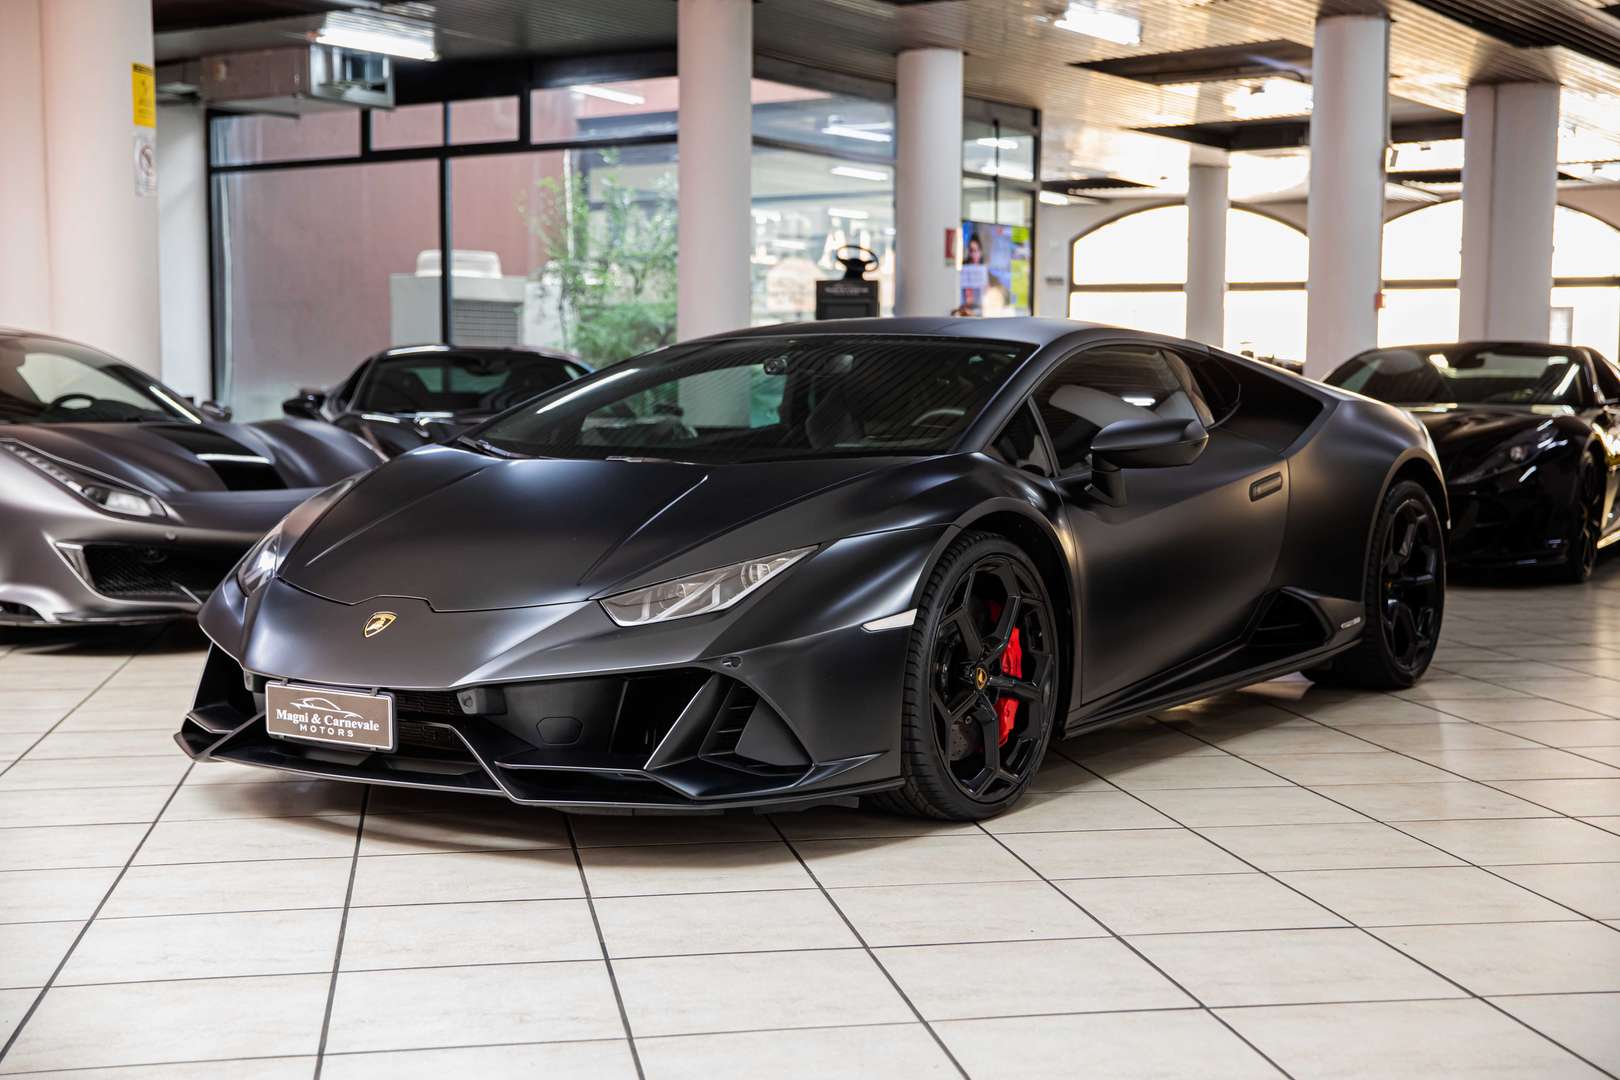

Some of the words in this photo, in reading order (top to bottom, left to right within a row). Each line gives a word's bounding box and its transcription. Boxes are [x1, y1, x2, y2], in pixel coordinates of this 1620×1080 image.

[276, 709, 308, 724] Magni
[311, 713, 321, 724] &
[324, 715, 379, 731] Carnevale
[300, 724, 353, 737] MOTORS
